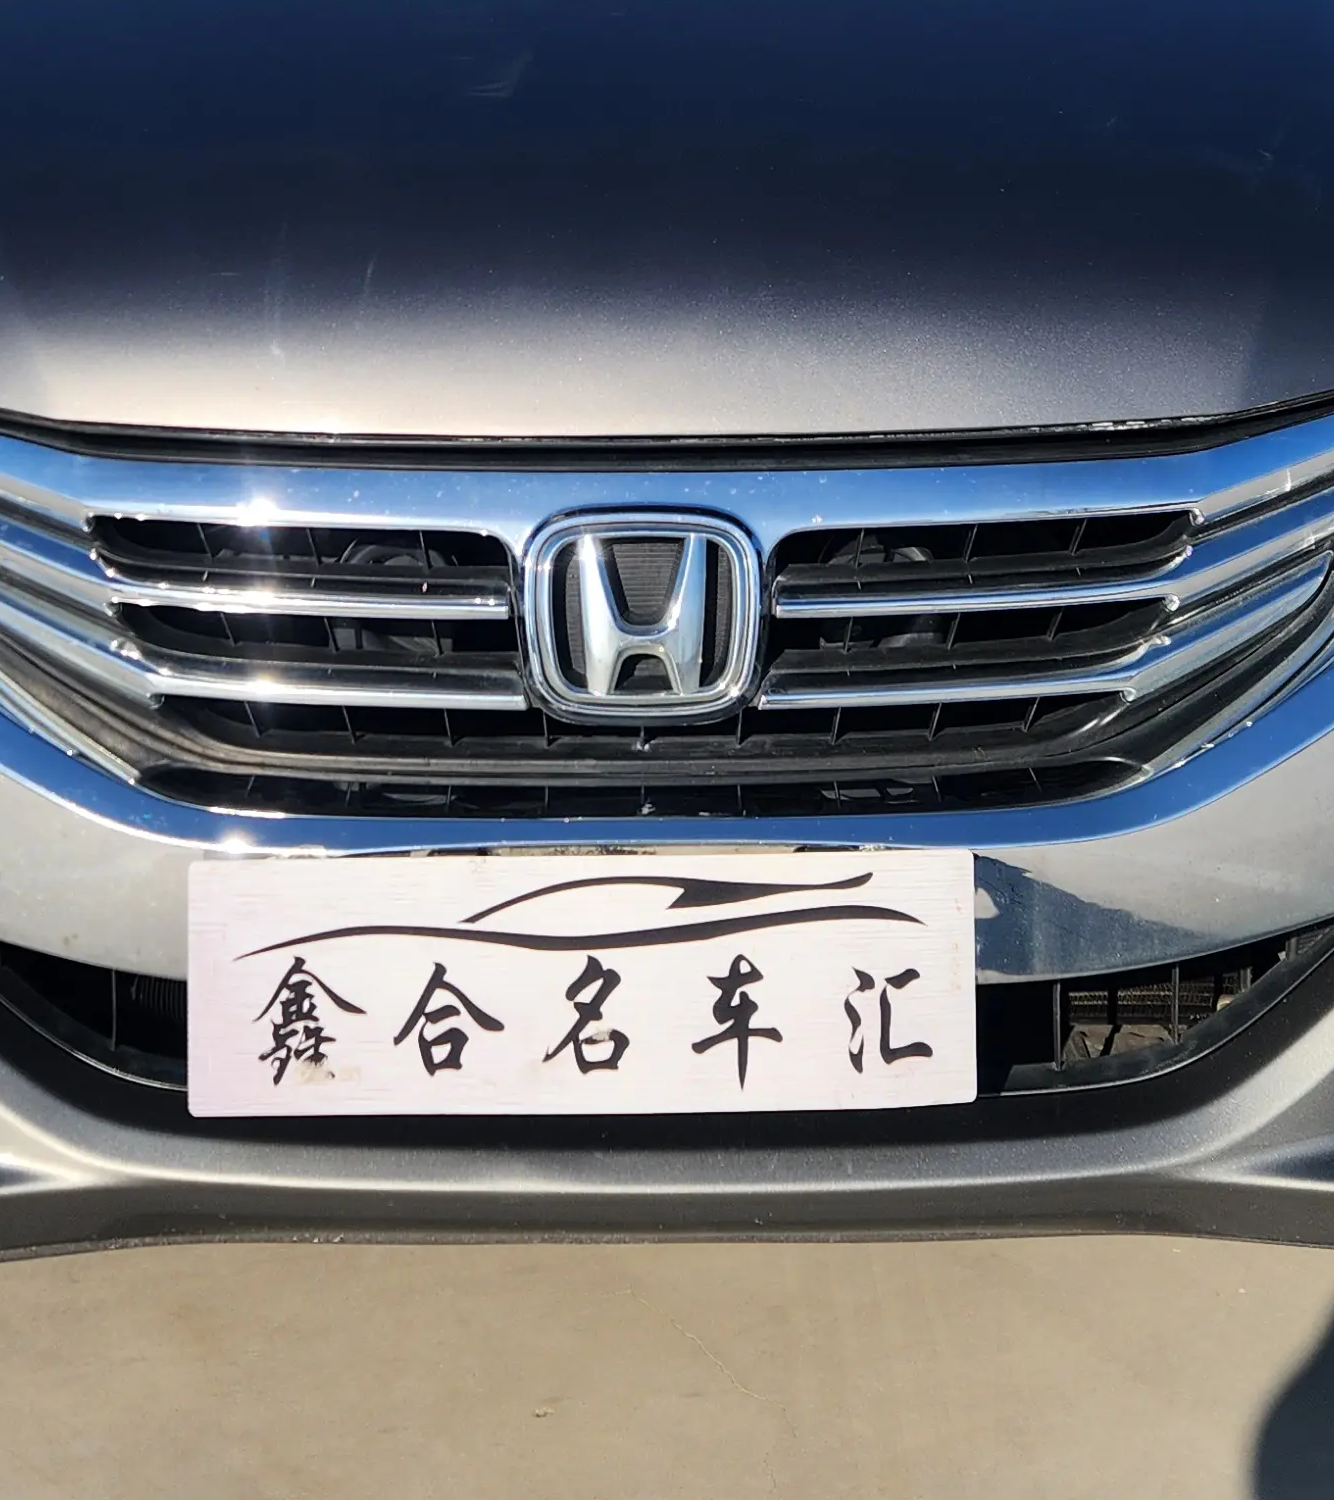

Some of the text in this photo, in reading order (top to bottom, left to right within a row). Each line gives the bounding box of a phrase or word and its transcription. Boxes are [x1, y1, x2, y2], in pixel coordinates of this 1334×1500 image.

[253, 953, 934, 1091] 鑫合名车汇
